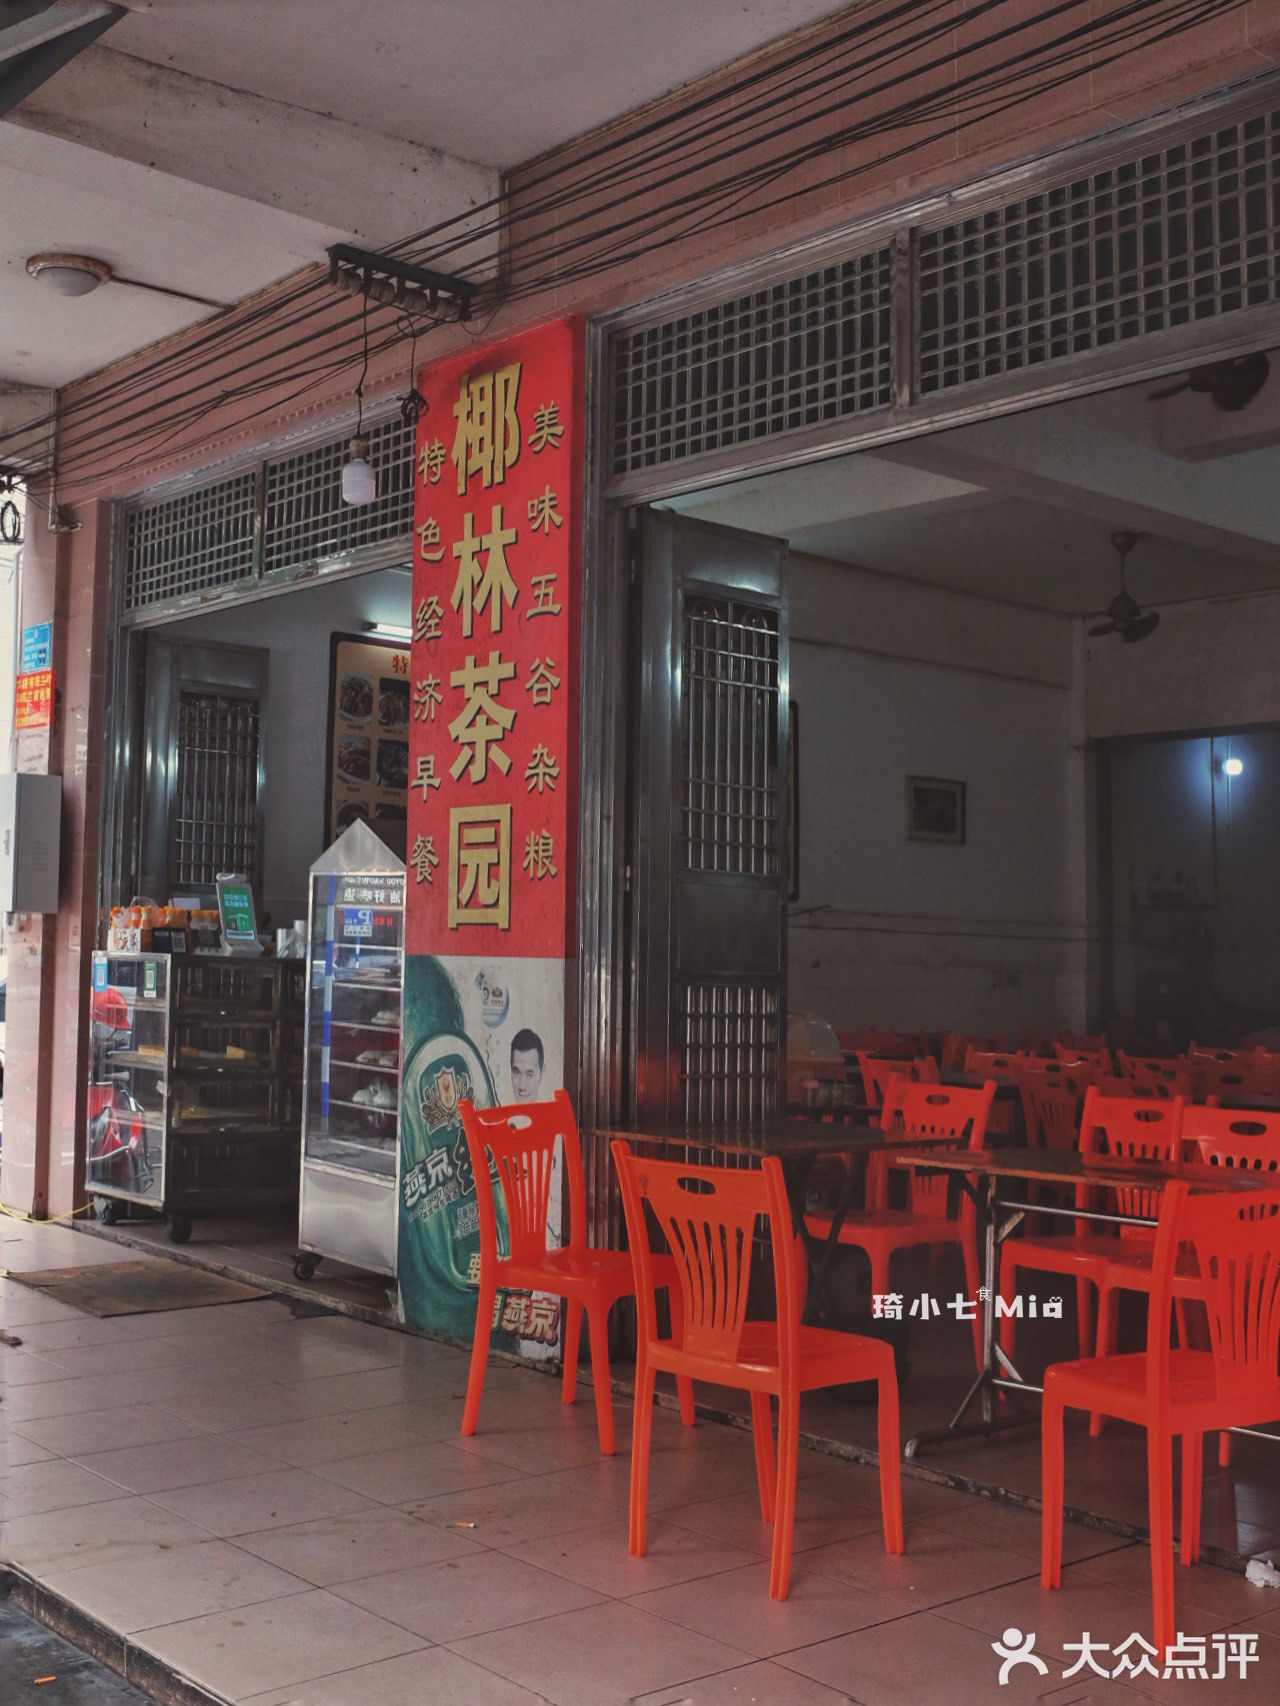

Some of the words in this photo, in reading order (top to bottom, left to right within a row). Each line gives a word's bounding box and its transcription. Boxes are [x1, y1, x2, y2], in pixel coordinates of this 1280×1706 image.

[409, 438, 446, 884] 特色经济早餐
[447, 362, 521, 930] 椰林茶园
[523, 400, 564, 880] 美味五谷杂粮
[402, 1146, 453, 1208] 燕京
